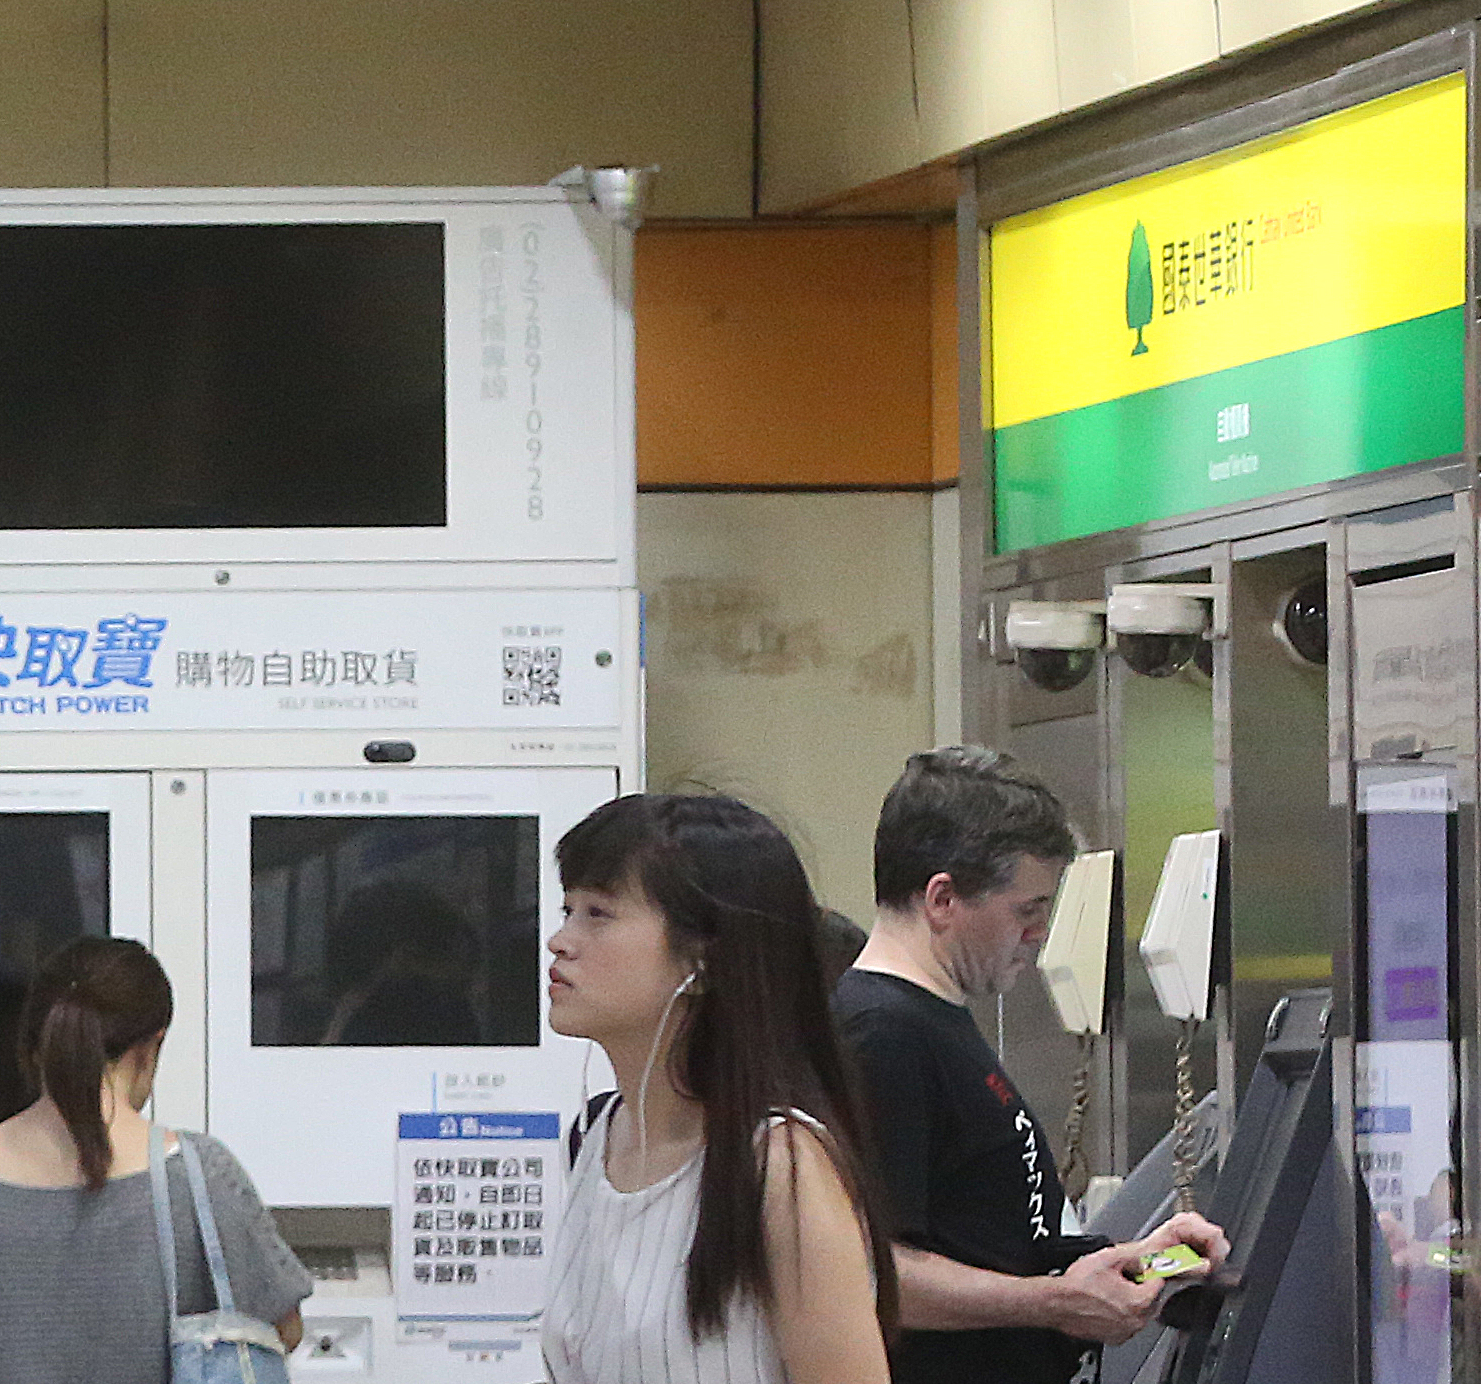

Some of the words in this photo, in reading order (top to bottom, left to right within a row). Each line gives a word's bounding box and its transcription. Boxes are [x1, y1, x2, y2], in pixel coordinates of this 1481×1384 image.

[1163, 219, 1254, 316] 國泰世華銀行
[175, 650, 417, 688] 購物自助取貨
[57, 695, 149, 714] POWER
[372, 695, 418, 710] STORE
[438, 1116, 480, 1137] 公告
[414, 1157, 544, 1179] 依快取寶公司
[413, 1209, 544, 1231] 起已停止訂取
